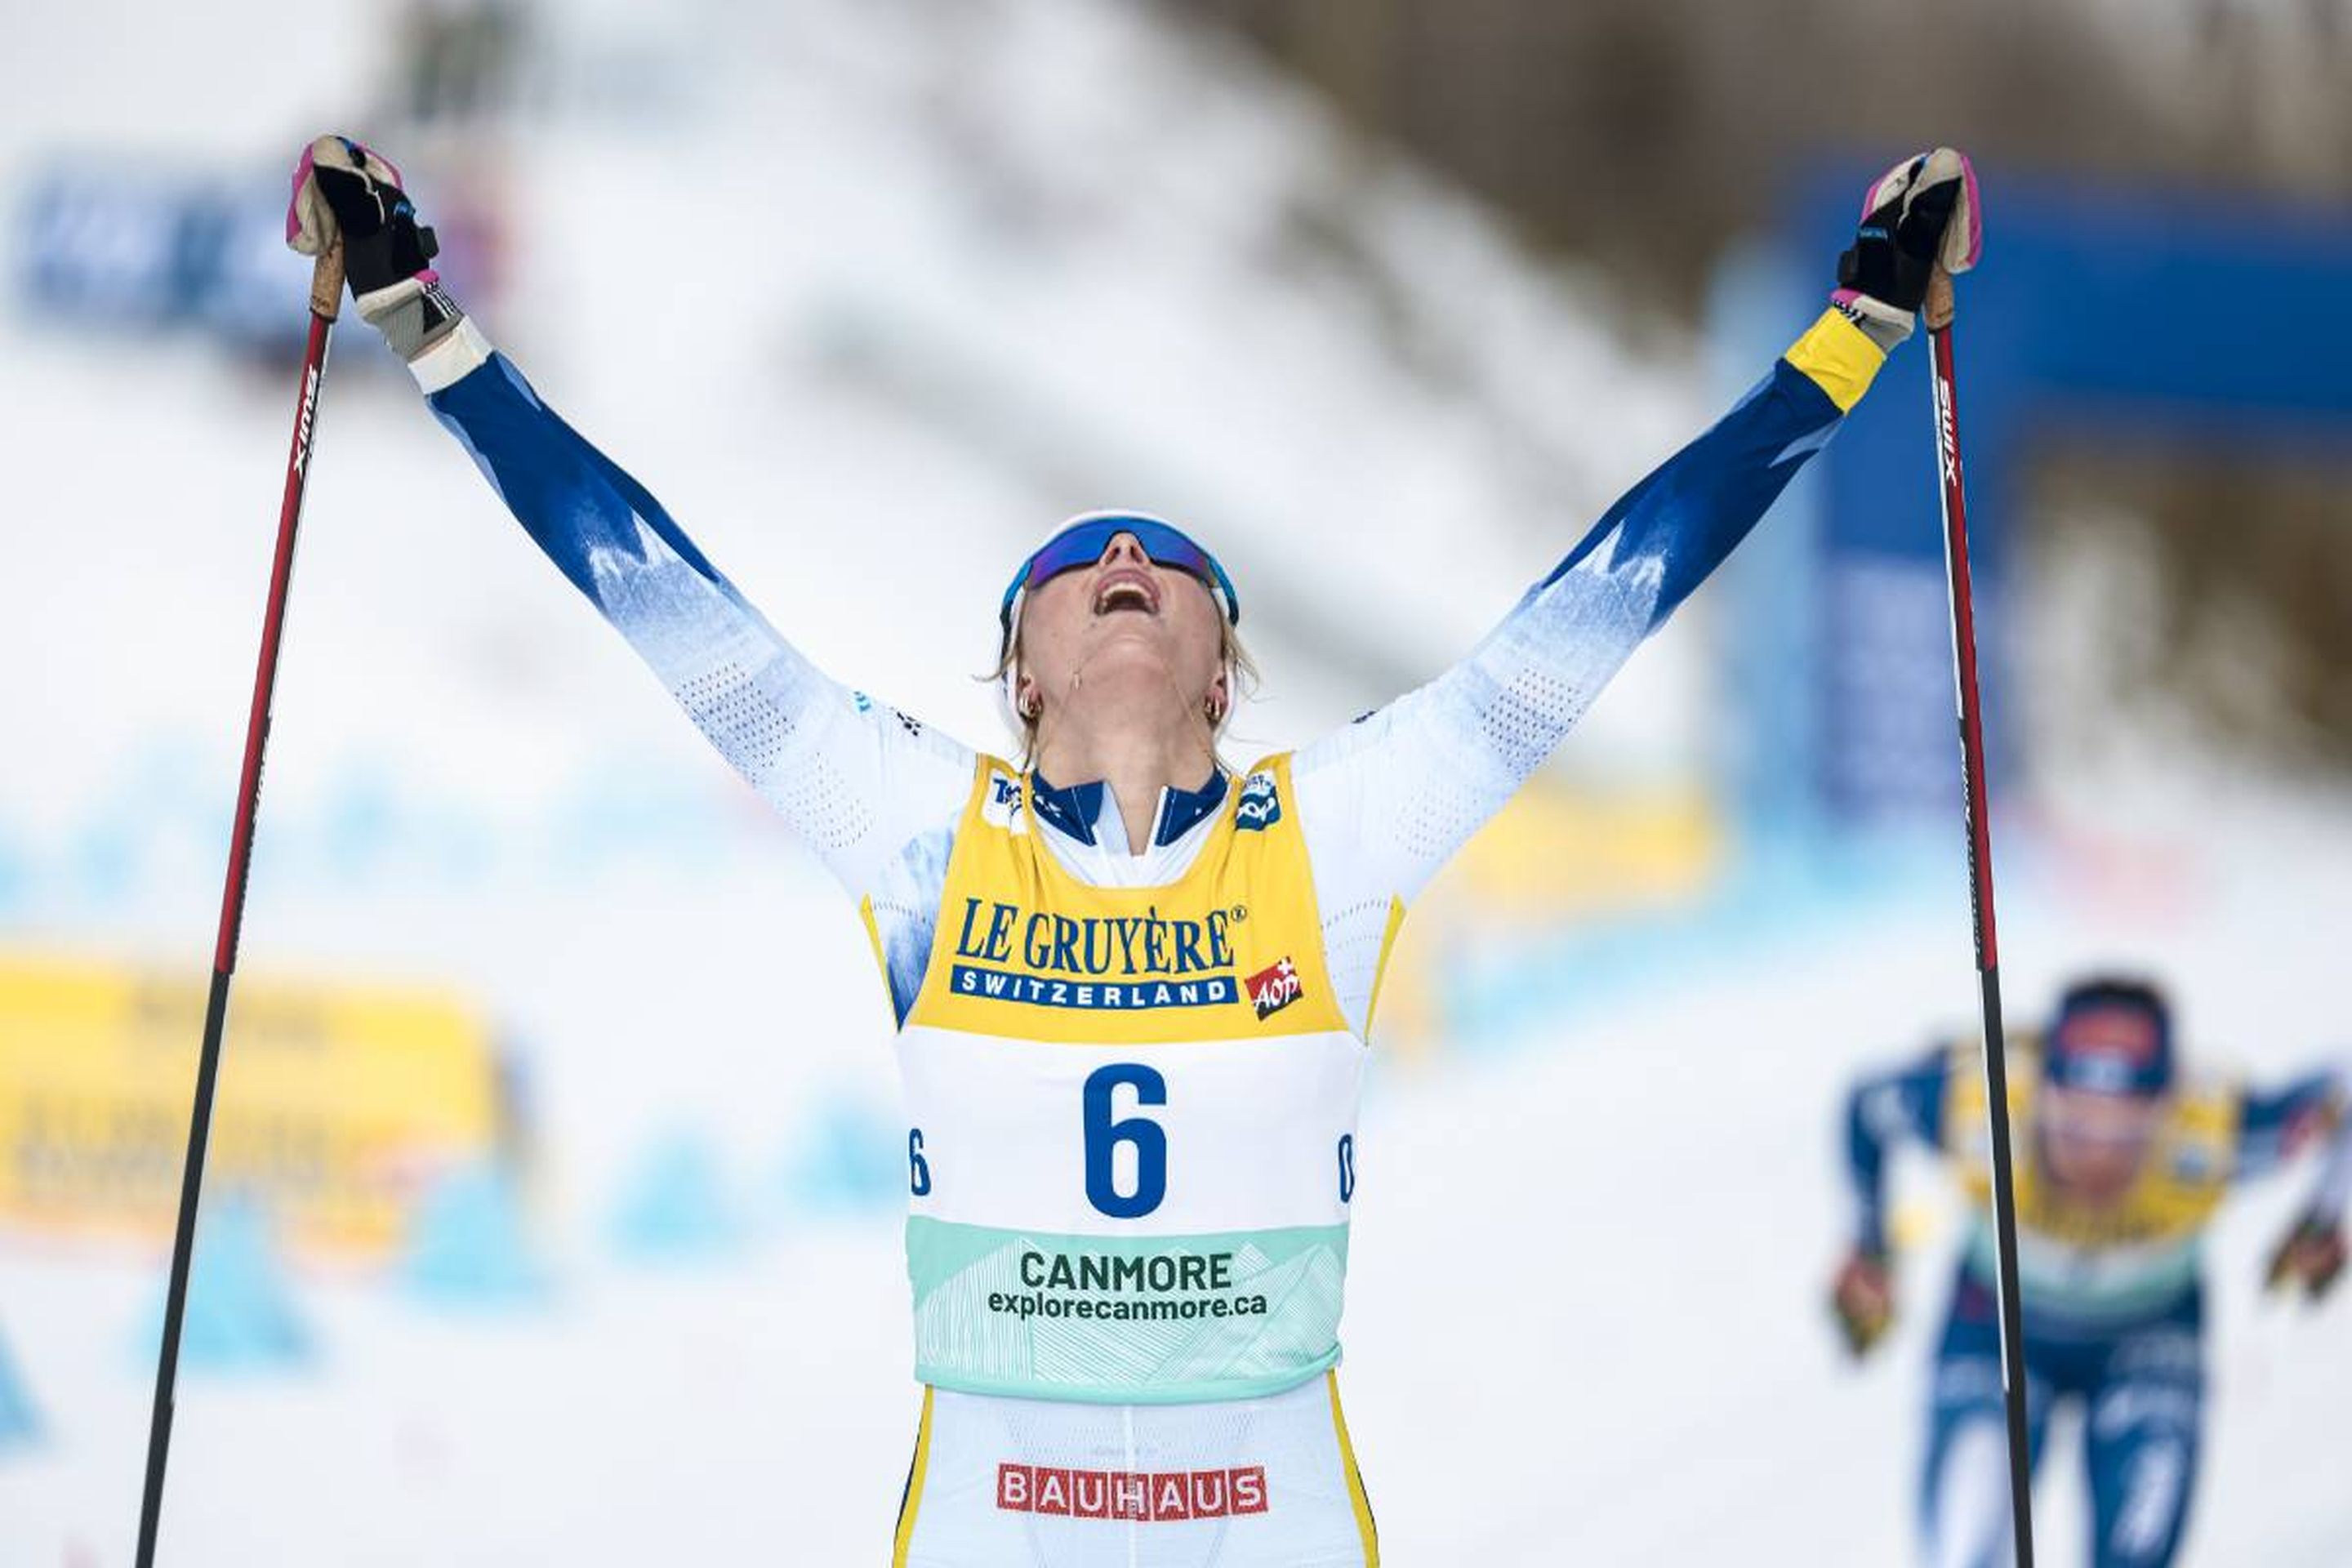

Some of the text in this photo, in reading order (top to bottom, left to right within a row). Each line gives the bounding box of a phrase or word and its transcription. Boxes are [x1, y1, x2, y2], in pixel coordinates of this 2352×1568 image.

[956, 898, 1018, 963] LE
[962, 970, 1226, 1004] SWITZERLAND
[1254, 974, 1299, 1011] AOP
[1083, 1063, 1166, 1218] 6
[909, 1129, 931, 1196] 6
[1020, 1252, 1232, 1292] CANMORE
[988, 1290, 1267, 1321] explorecanmore.ca
[1003, 1471, 1263, 1513] BAUHAUS
